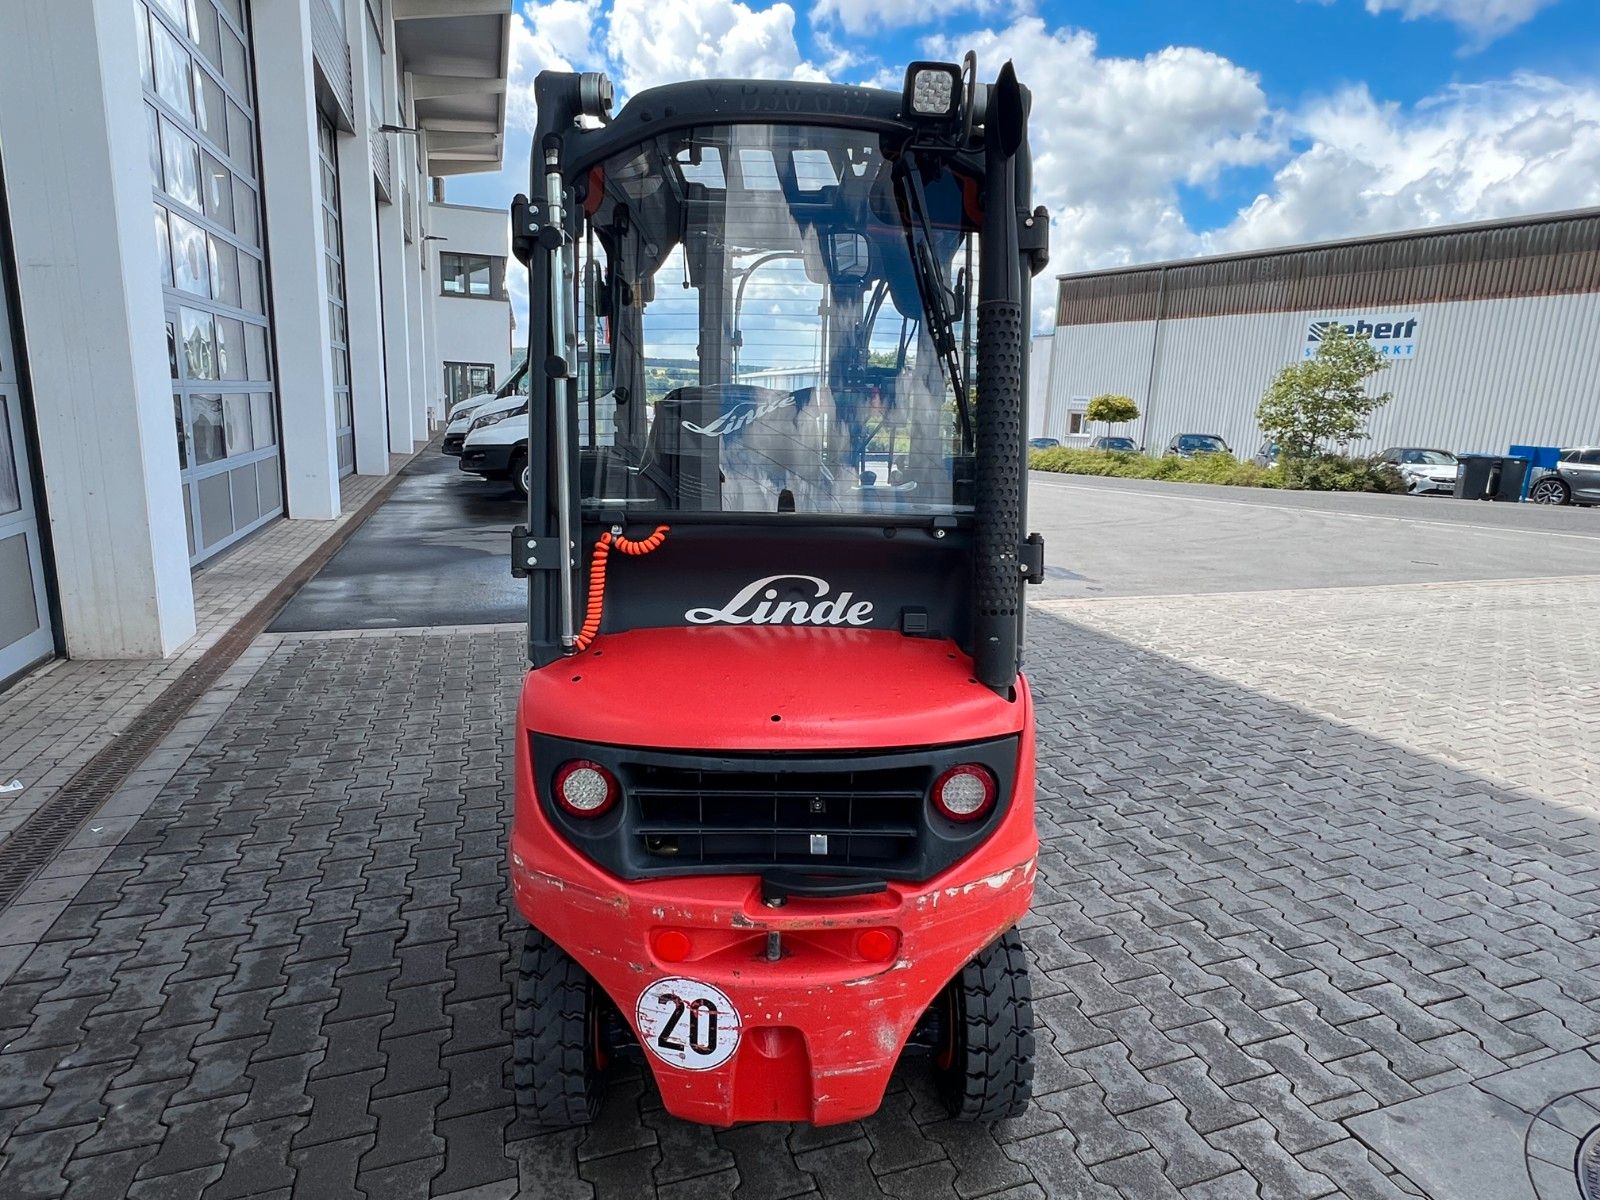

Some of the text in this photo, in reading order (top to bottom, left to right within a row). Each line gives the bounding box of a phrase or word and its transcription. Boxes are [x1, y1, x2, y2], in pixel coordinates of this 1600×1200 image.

[681, 396, 796, 437] Linde
[684, 574, 874, 626] Linde
[657, 993, 718, 1055] 20
